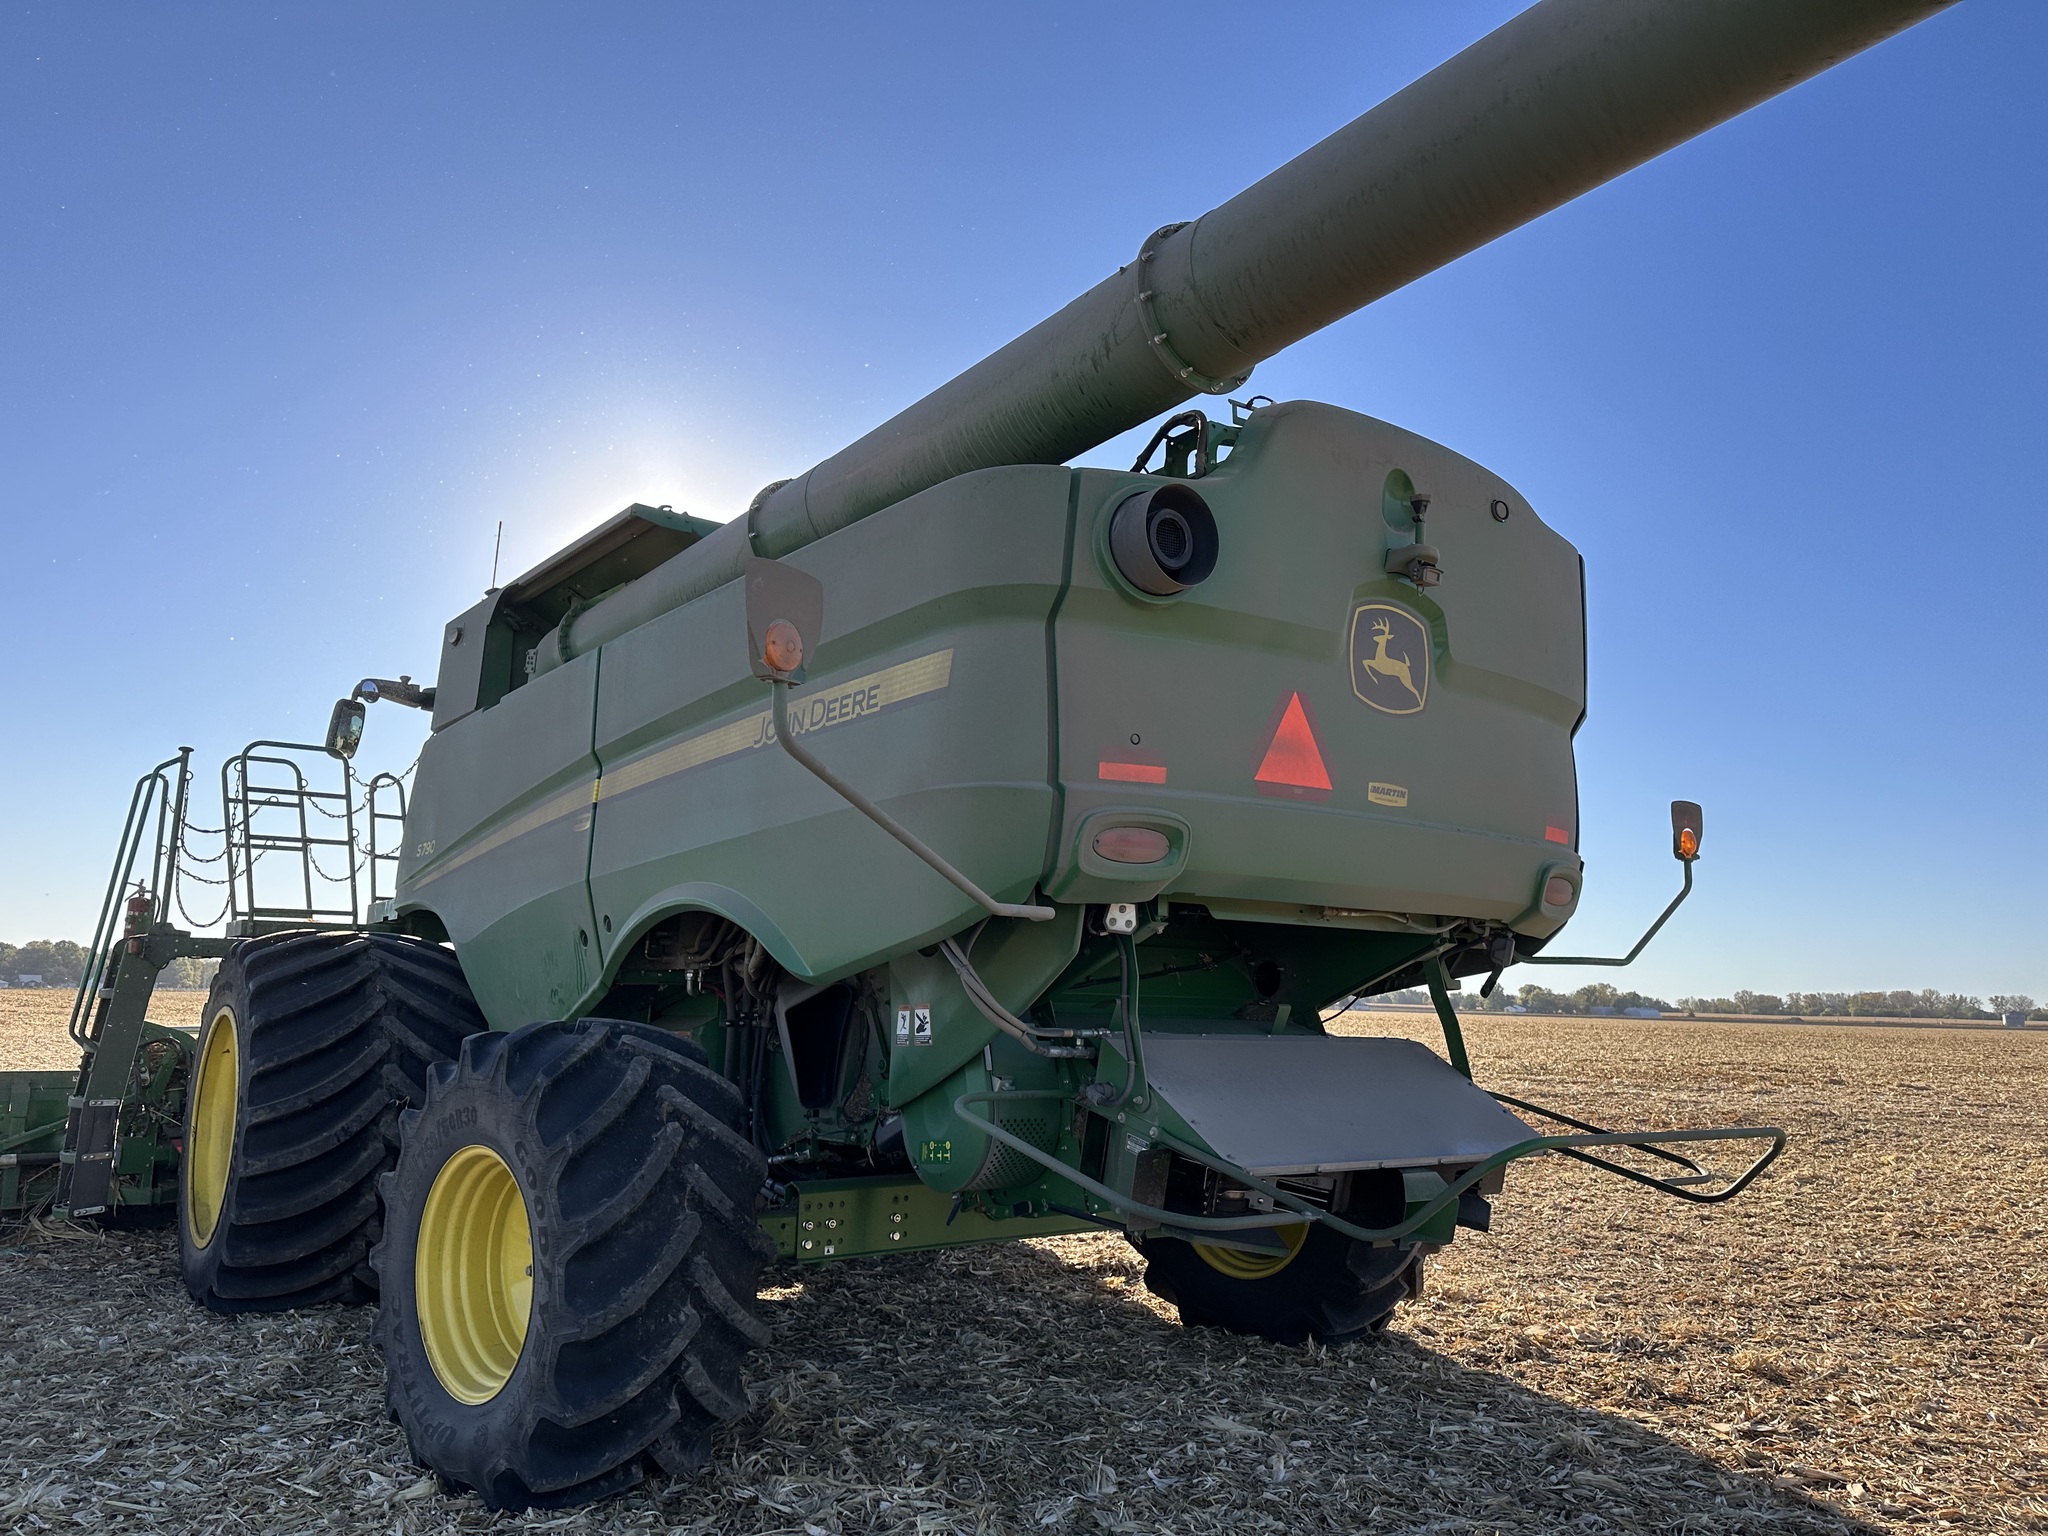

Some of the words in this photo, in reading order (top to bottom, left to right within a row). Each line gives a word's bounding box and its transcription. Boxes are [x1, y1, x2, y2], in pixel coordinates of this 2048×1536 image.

[753, 707, 806, 745] JON
[809, 683, 880, 727] DEERE
[1370, 785, 1407, 799] MARTIN
[416, 839, 436, 858] S790
[504, 1140, 555, 1427] GOODYEAR
[391, 1295, 457, 1448] OPTITRAC
